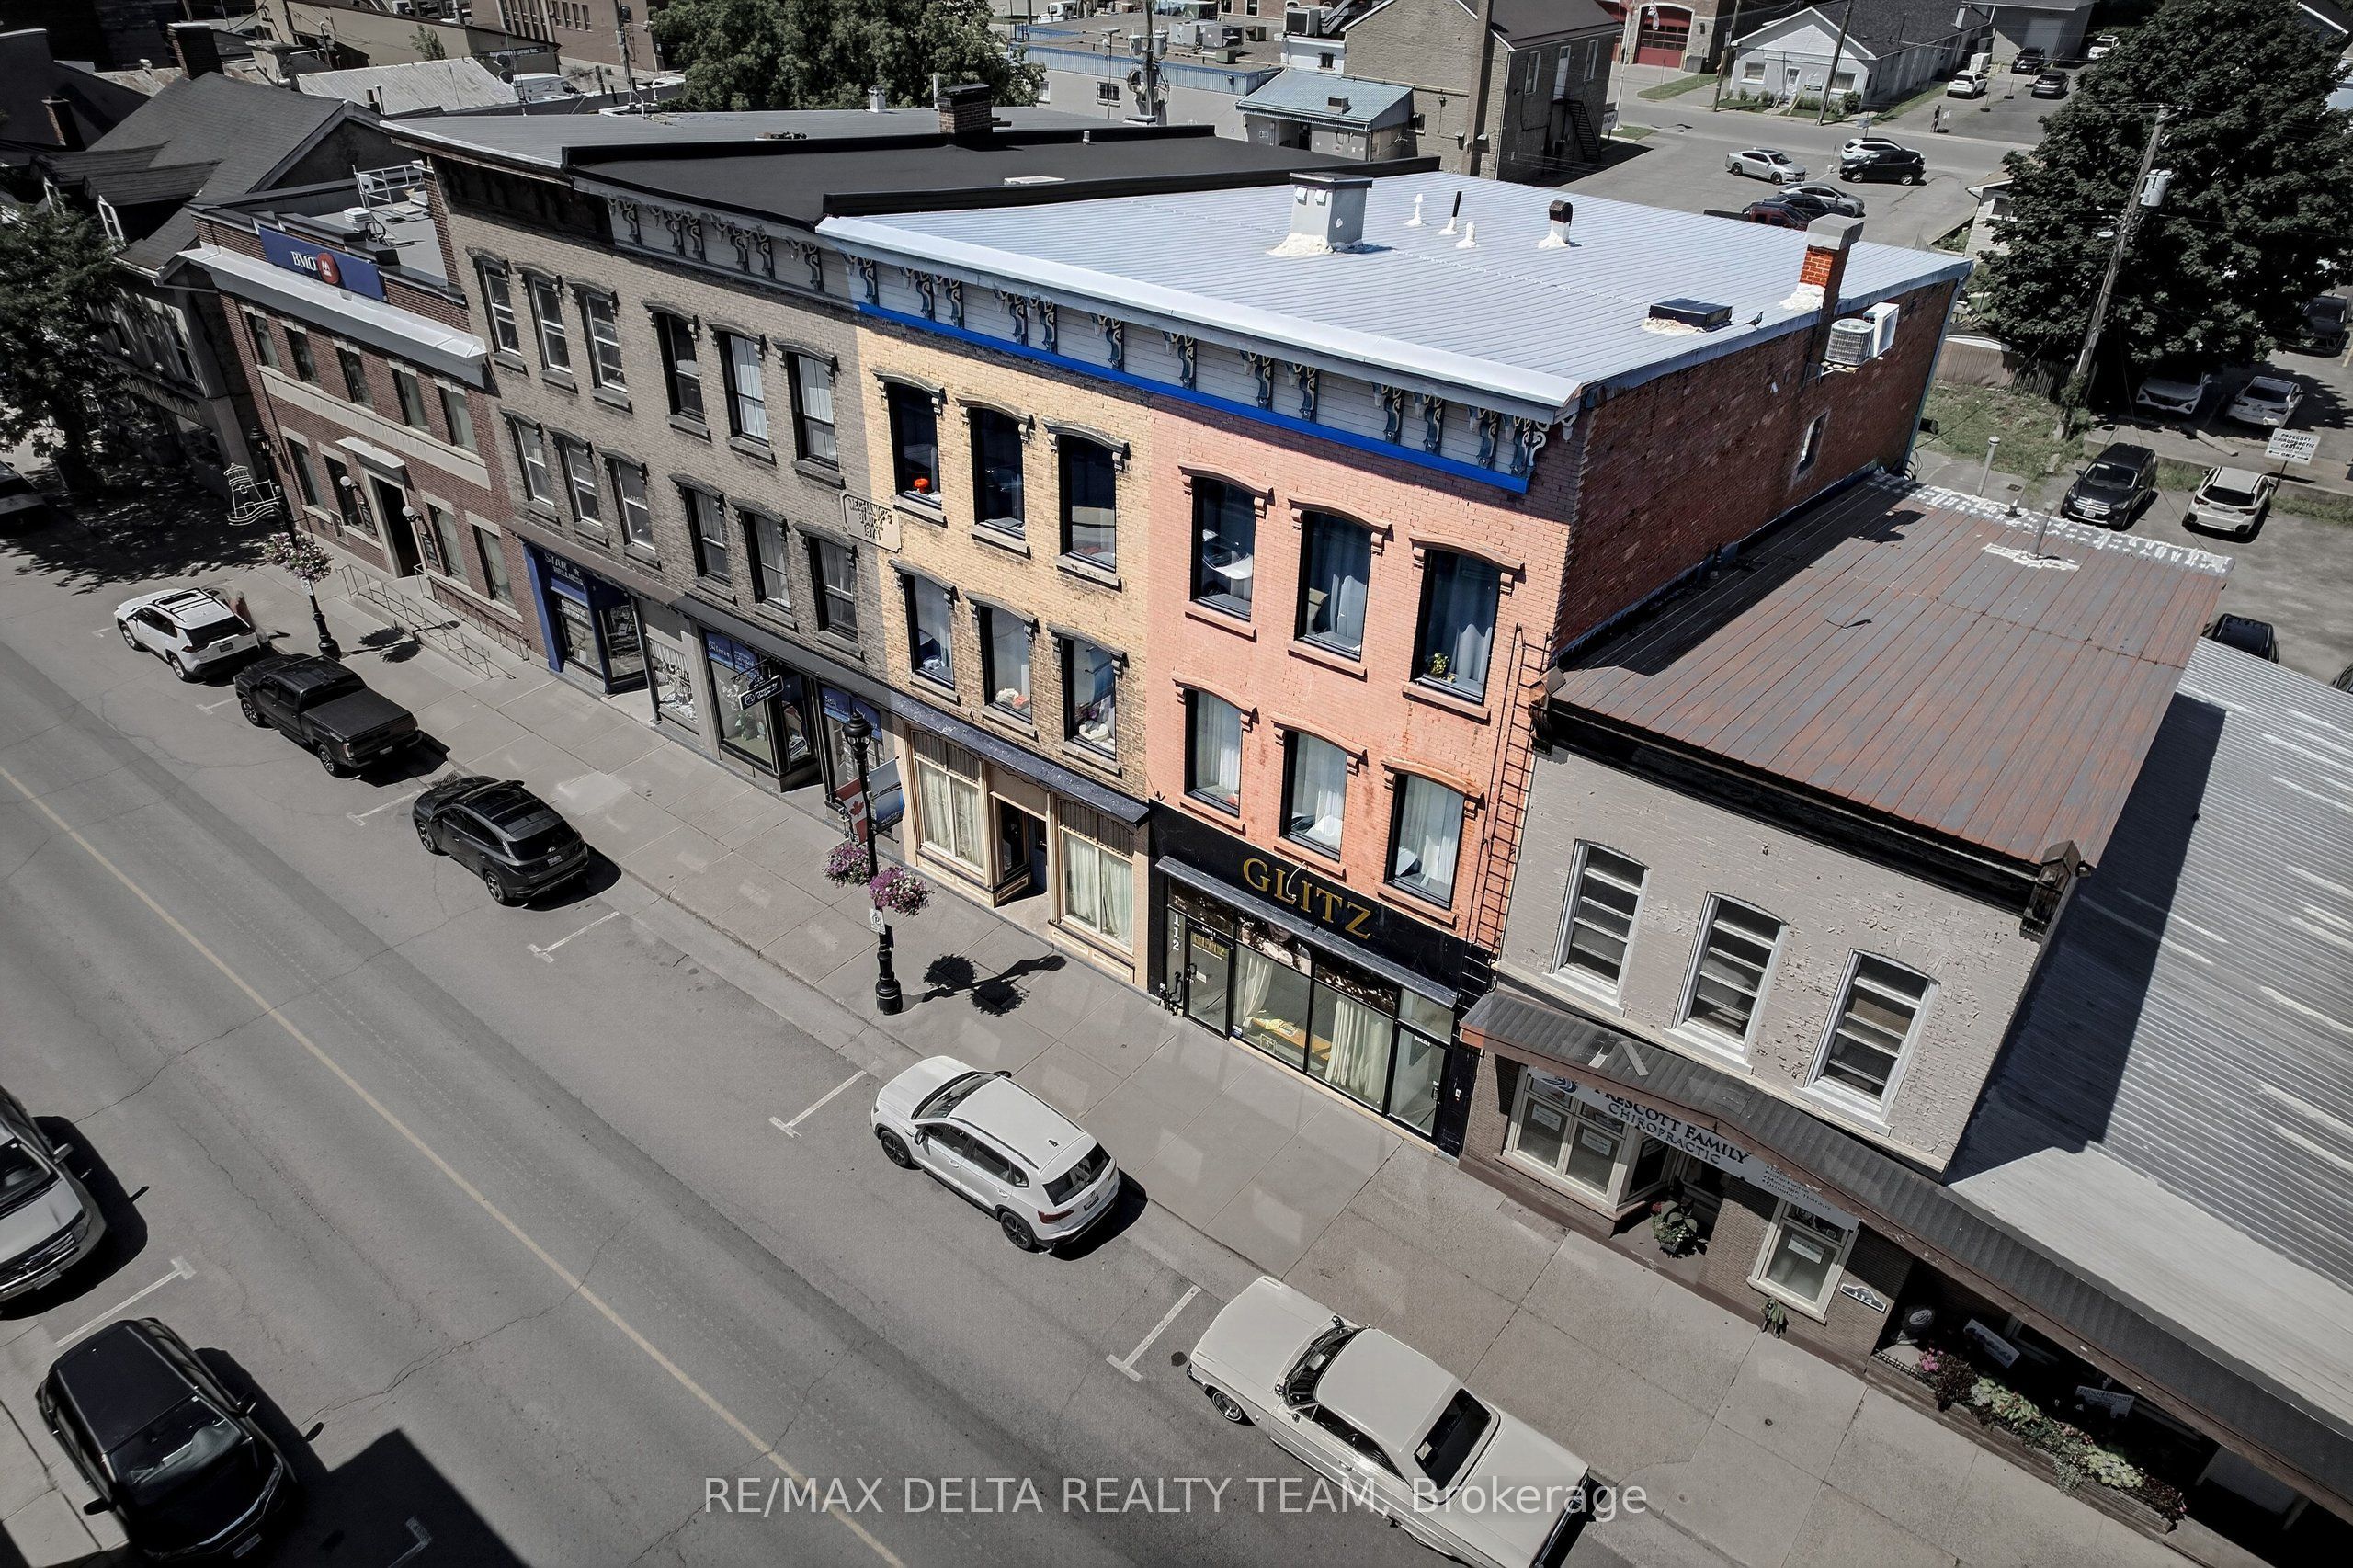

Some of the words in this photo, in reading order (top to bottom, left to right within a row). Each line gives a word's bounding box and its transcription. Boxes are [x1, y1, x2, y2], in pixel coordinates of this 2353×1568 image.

[290, 251, 317, 271] BMO
[1243, 858, 1372, 940] GLITZ
[1595, 1088, 1681, 1141] RESCOTT
[1685, 1124, 1752, 1165] FAMILY
[1608, 1102, 1722, 1165] CHIROPRACTIC
